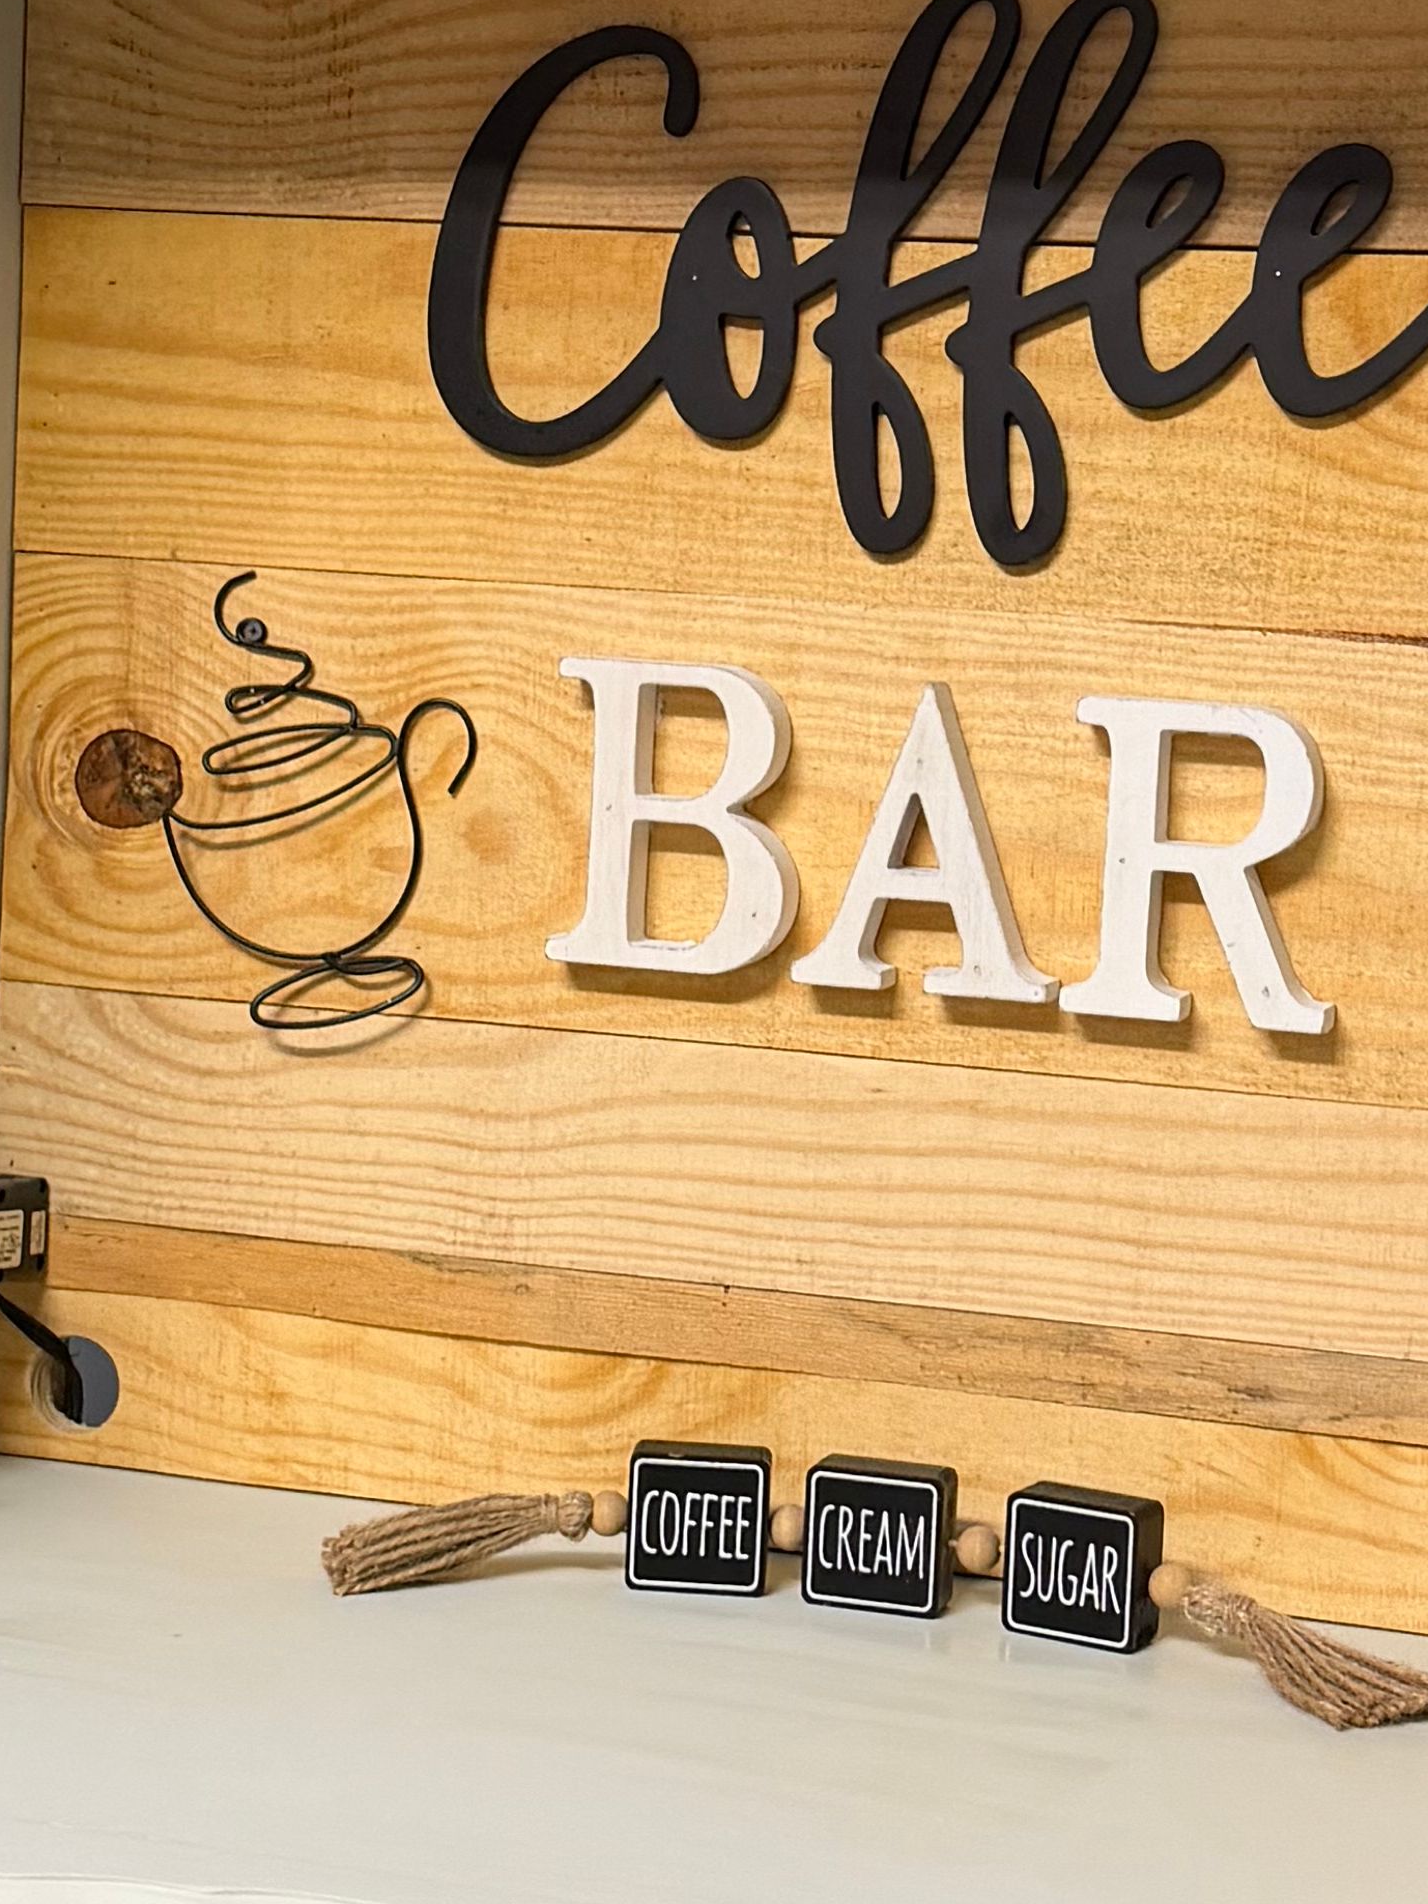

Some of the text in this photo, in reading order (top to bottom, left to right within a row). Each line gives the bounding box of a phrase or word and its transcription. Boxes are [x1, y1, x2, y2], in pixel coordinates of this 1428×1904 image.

[545, 657, 1338, 1034] BAR
[640, 1489, 752, 1561] COFFEE
[819, 1504, 926, 1580] CREAM
[1020, 1531, 1122, 1614] SUGAR
